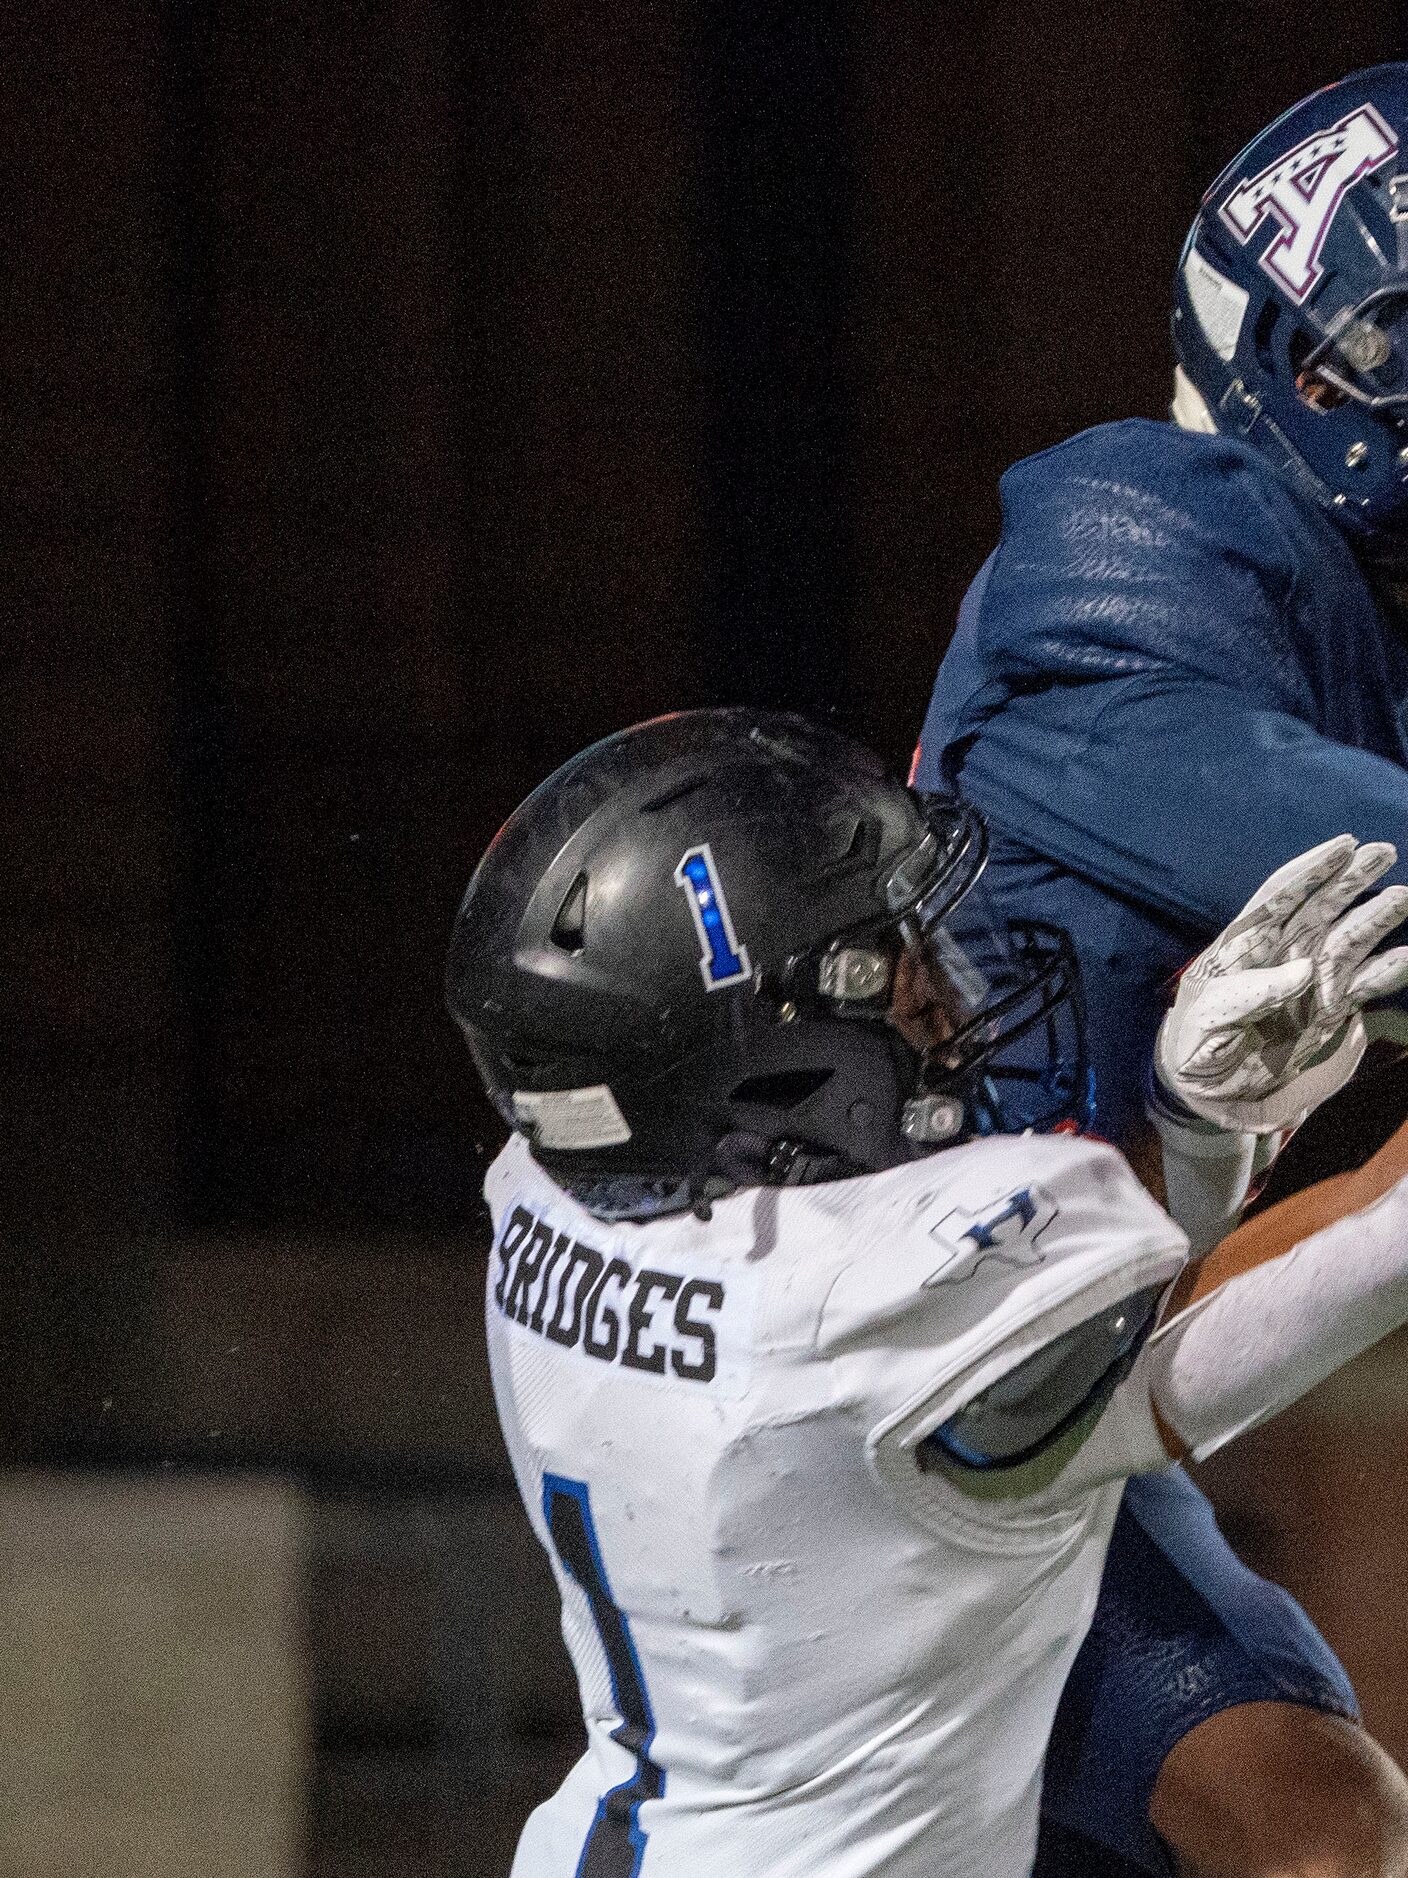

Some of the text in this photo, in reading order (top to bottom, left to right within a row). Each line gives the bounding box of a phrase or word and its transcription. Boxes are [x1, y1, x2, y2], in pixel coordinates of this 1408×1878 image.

[1218, 102, 1399, 306] A
[674, 843, 752, 992] 1
[542, 1471, 666, 1878] 1
